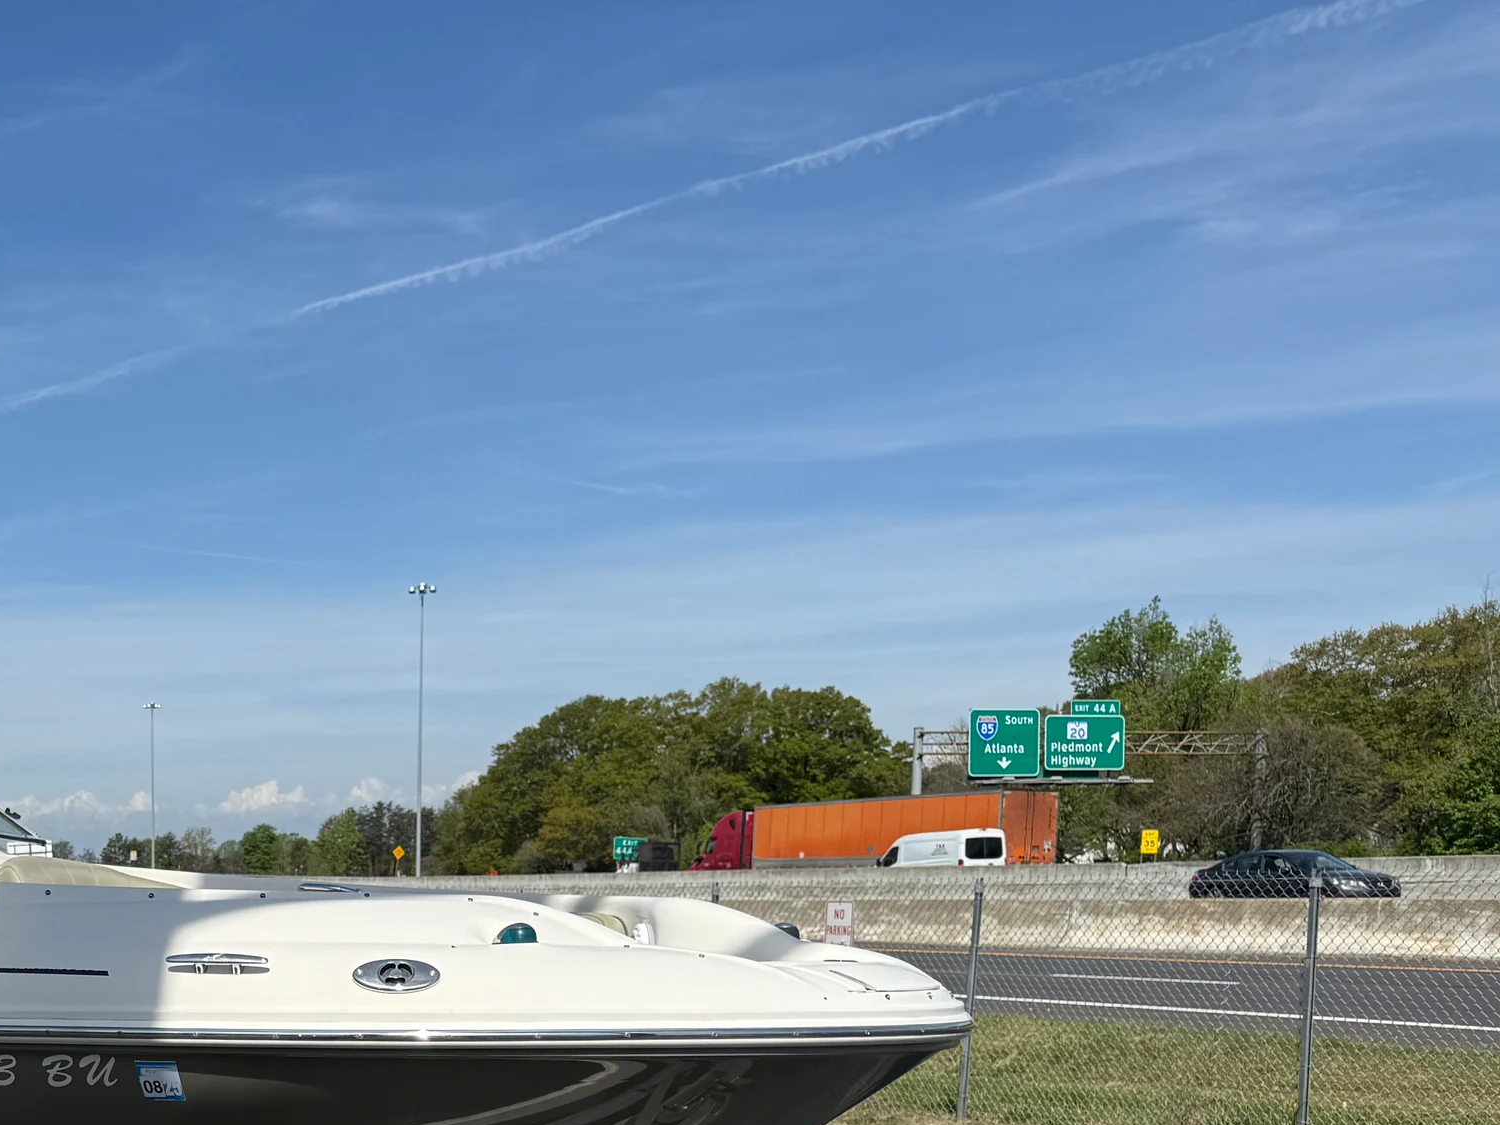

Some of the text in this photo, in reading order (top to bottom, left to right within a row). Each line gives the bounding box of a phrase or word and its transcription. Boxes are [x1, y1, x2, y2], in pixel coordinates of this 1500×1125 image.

[1074, 703, 1116, 713] EXIT 44 A
[981, 723, 994, 735] 85
[1005, 715, 1033, 725] SOUTH
[1070, 728, 1085, 738] 20
[984, 743, 1025, 754] Atlanta
[1051, 741, 1103, 753] Piedmont
[1051, 755, 1097, 768] Highway
[1144, 840, 1156, 848] 35
[833, 908, 845, 920] NO
[41, 1054, 119, 1087] BU
[143, 1080, 163, 1094] 08
